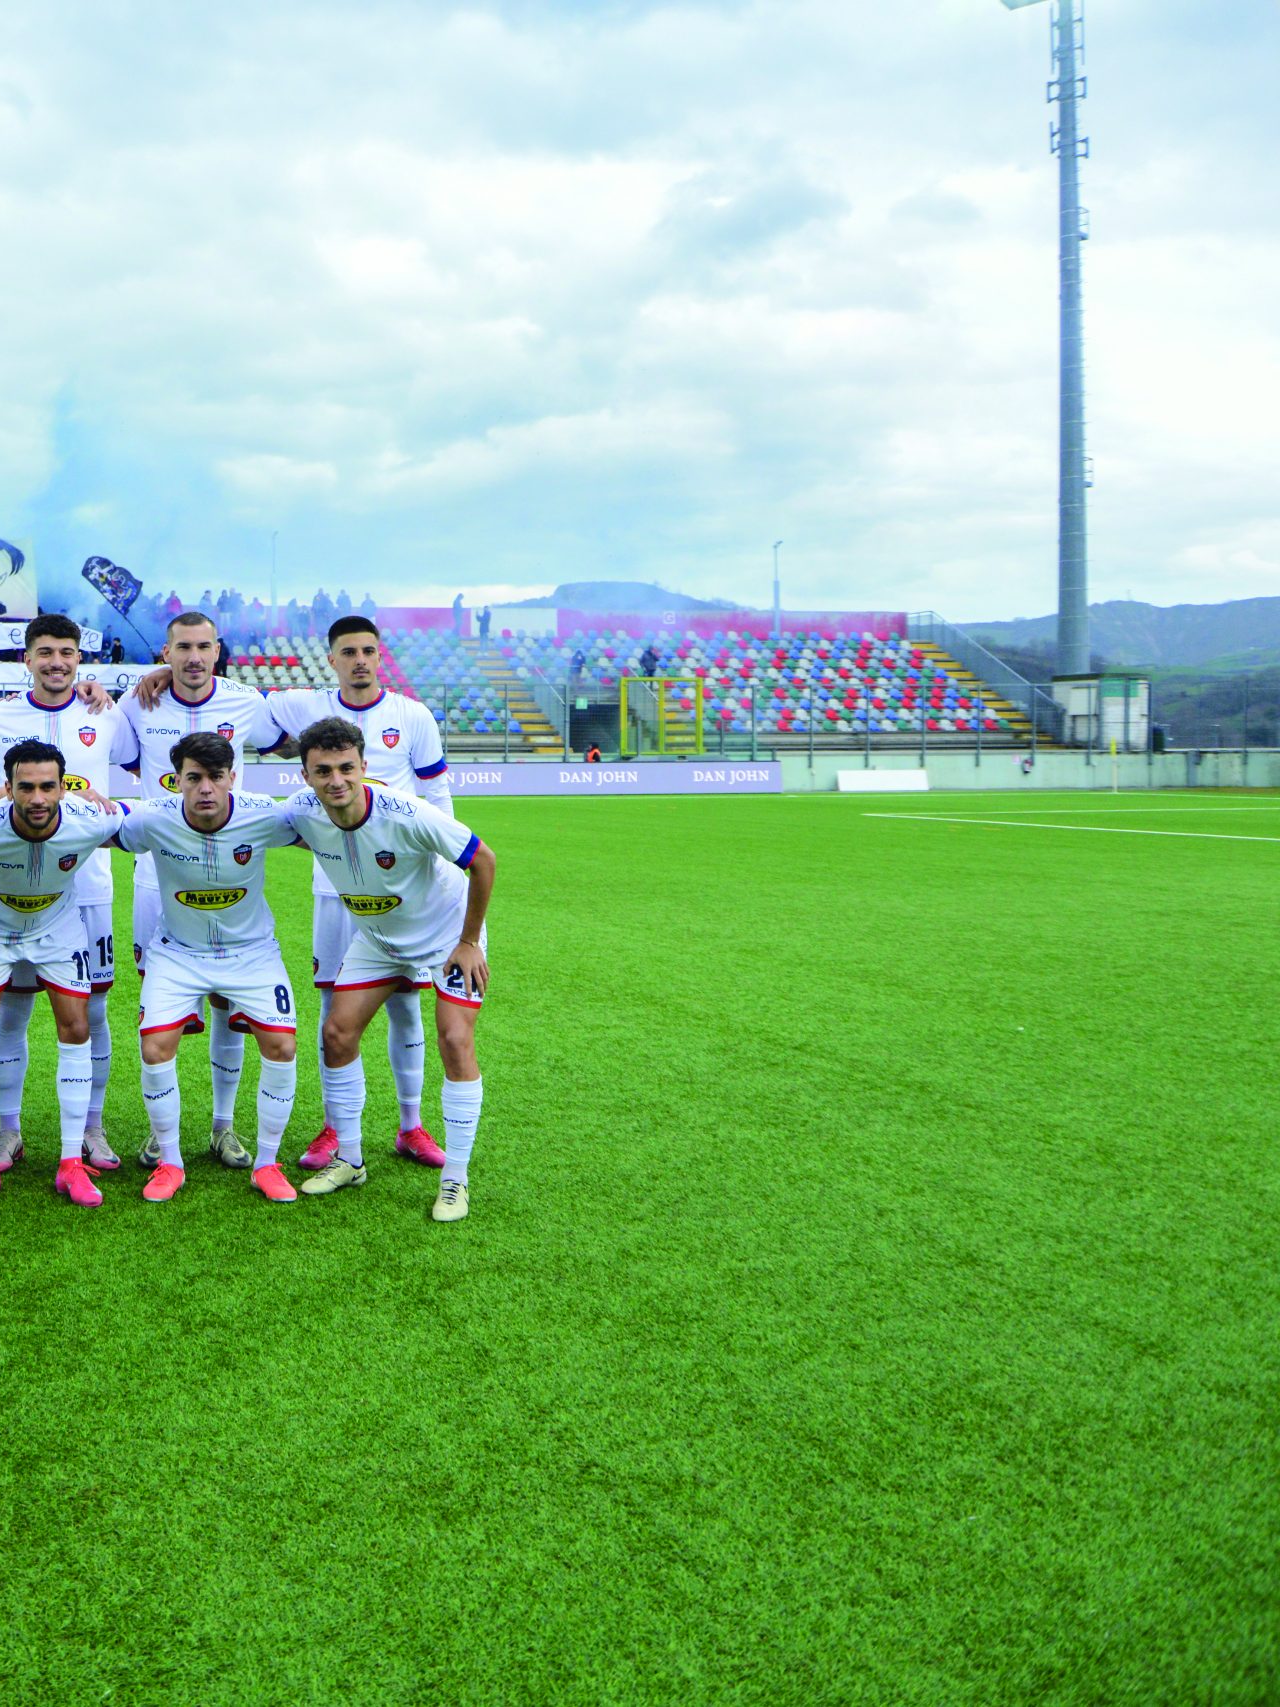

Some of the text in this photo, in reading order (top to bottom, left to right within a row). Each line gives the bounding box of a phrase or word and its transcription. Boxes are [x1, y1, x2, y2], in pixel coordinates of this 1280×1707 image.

[146, 727, 180, 736] GIVOVA
[278, 773, 308, 785] DA
[459, 772, 503, 786] JOHN
[559, 771, 639, 785] DAN JOHN
[693, 770, 769, 784] DAN JOHN
[160, 850, 200, 863] GIVOVA
[96, 936, 113, 967] 19
[92, 971, 115, 979] GIVO
[71, 980, 90, 988] GIVO
[274, 985, 291, 1014] 8
